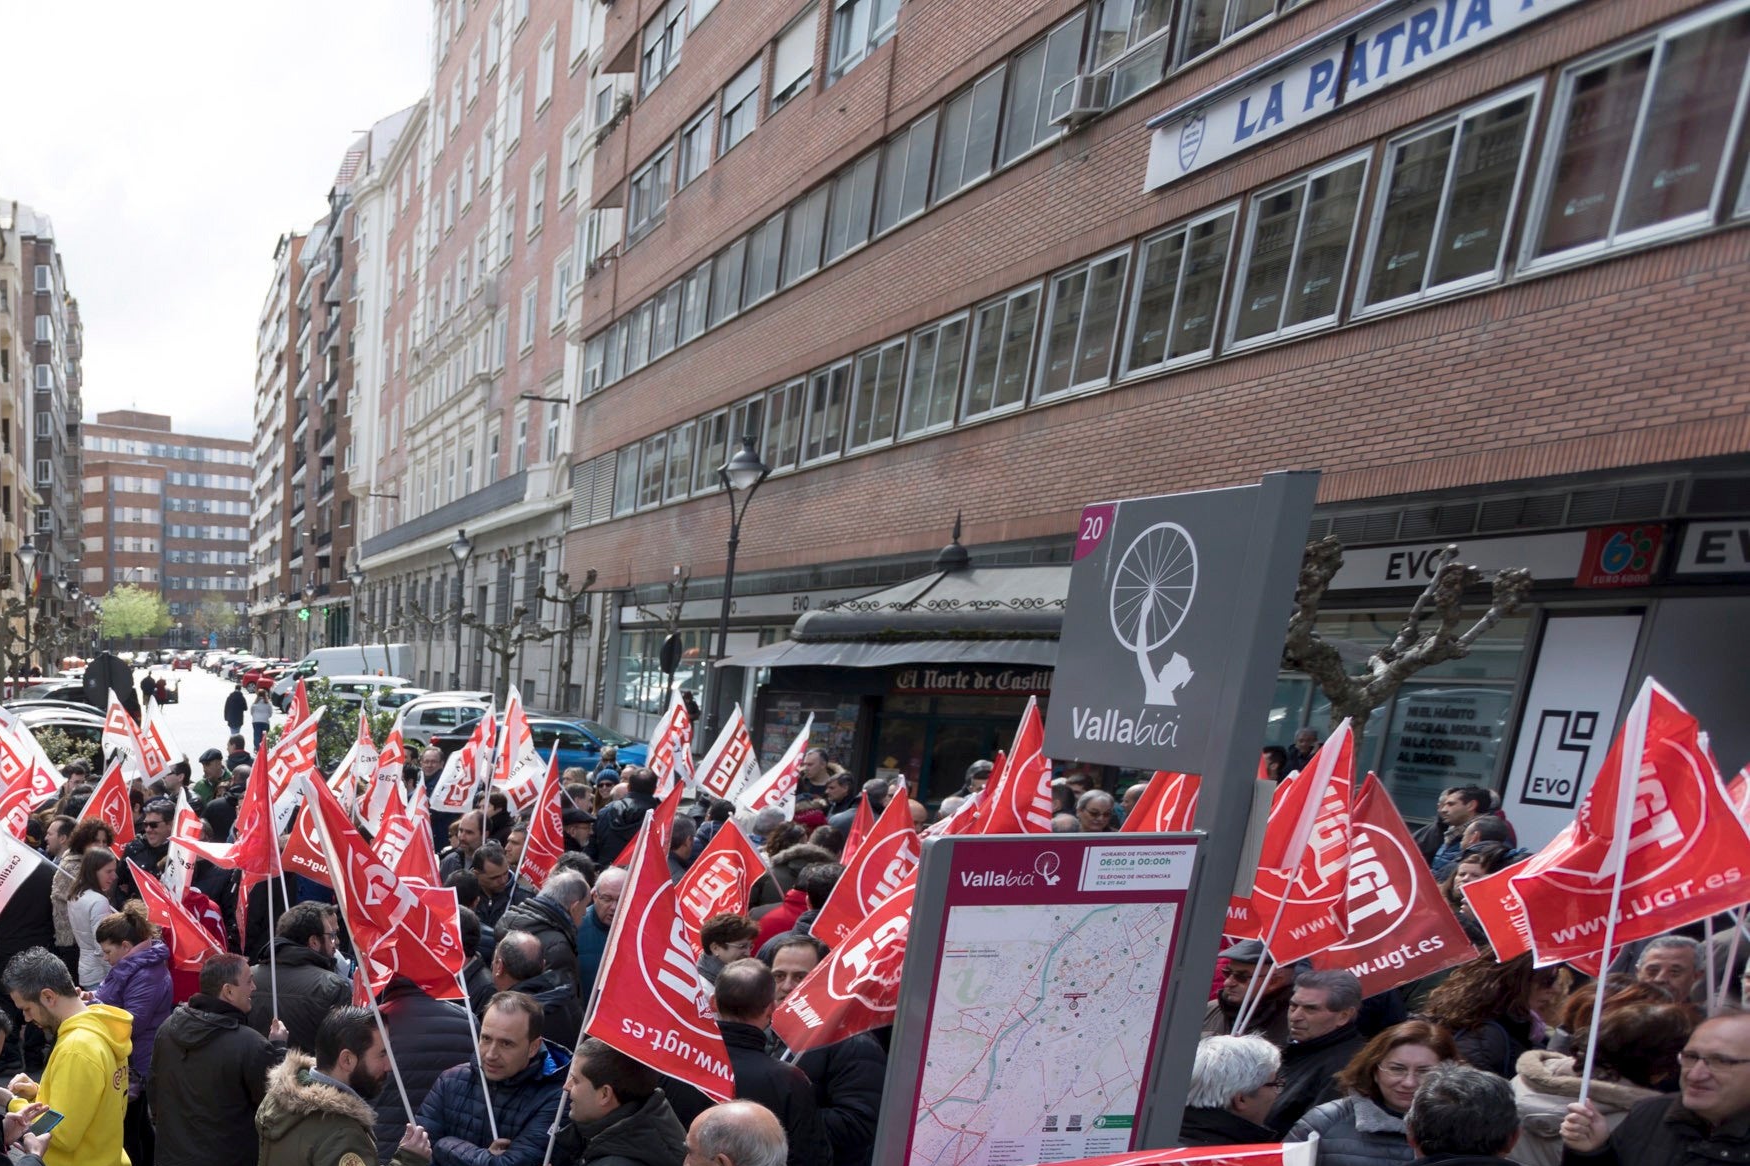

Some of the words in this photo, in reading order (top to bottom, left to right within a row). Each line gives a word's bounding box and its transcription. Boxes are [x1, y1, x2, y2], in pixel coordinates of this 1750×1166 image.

[1233, 81, 1284, 144] LA
[1302, 0, 1494, 112] PATRIA
[1081, 516, 1103, 540] 20
[1592, 575, 1619, 584] EURO
[1621, 573, 1649, 584] 6000
[896, 669, 917, 688] El
[923, 669, 970, 690] Norte
[974, 670, 994, 688] de
[1072, 706, 1181, 748] Vallabici
[1532, 777, 1571, 796] EVO
[960, 869, 1035, 887] Vallabici
[1099, 858, 1127, 866] 06:00
[1138, 857, 1171, 866] 00:00h
[356, 852, 420, 929] GT
[682, 855, 739, 924] UGT
[1348, 832, 1404, 936] UGT
[1345, 934, 1444, 978] w.ugt.es
